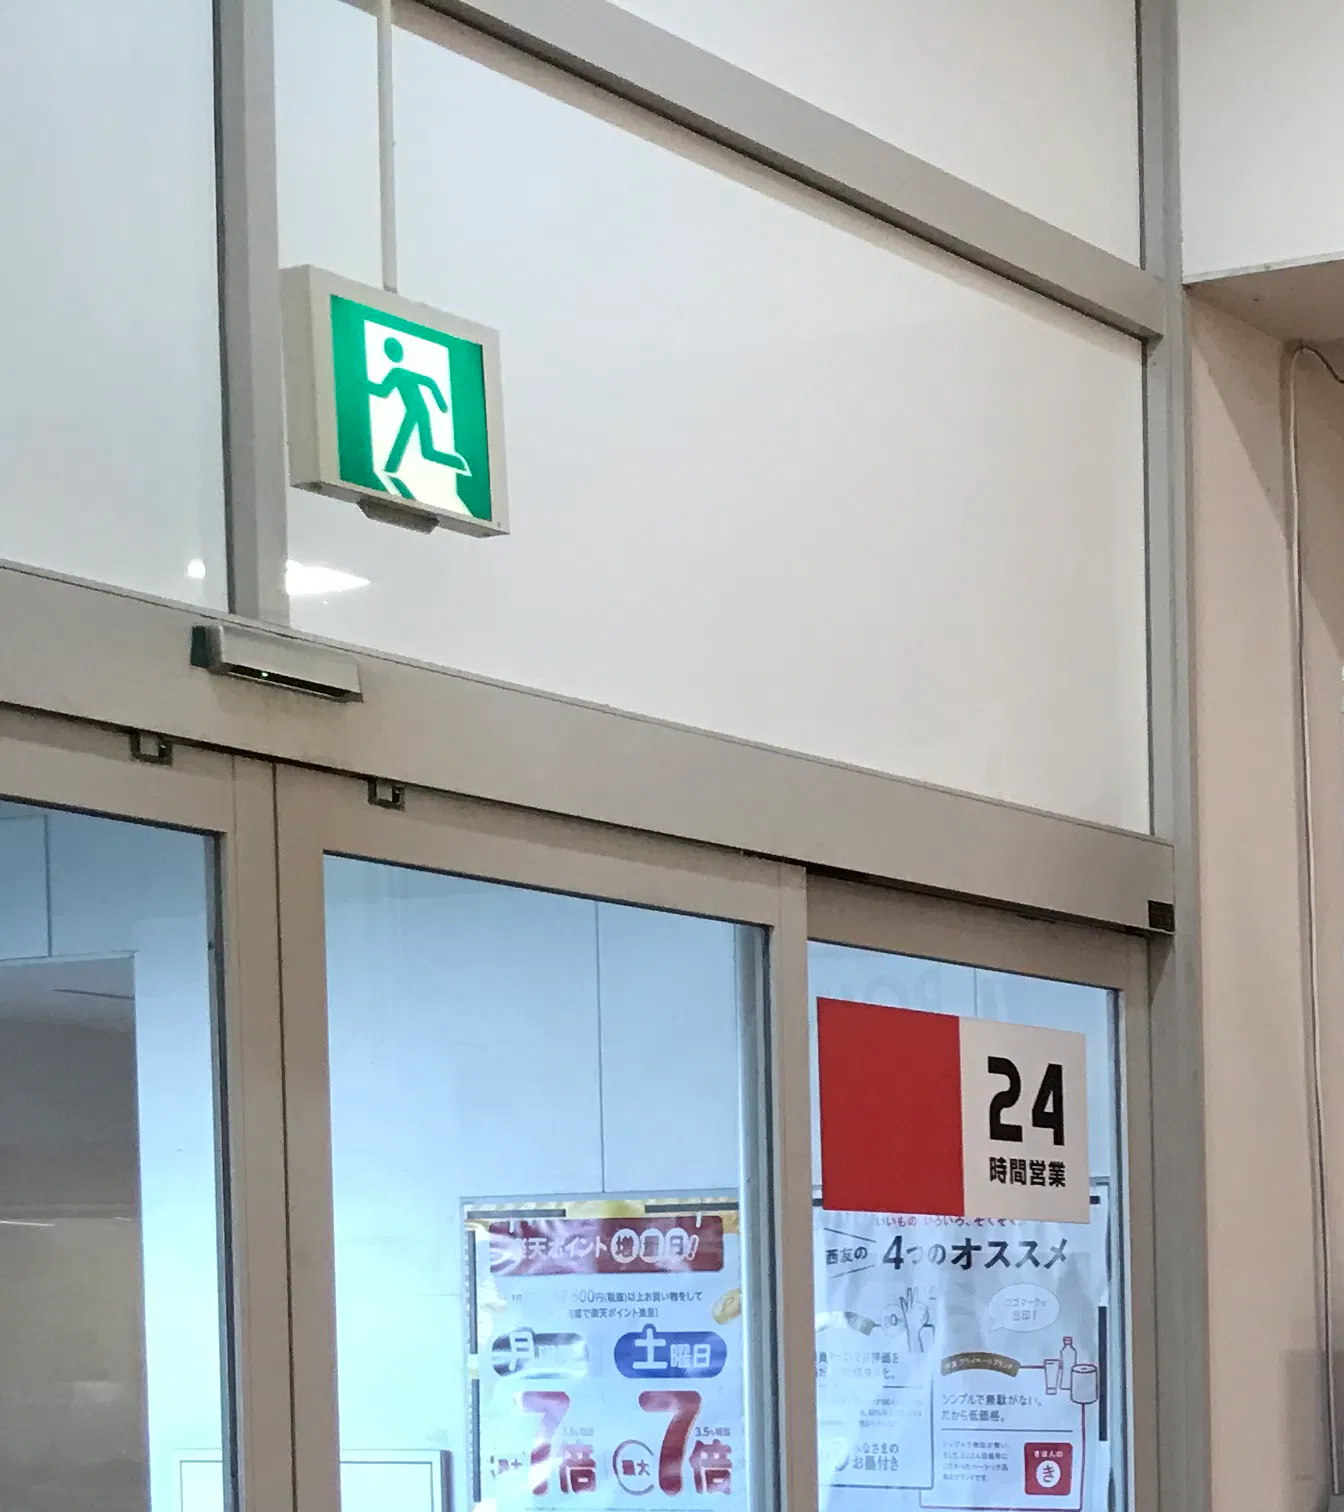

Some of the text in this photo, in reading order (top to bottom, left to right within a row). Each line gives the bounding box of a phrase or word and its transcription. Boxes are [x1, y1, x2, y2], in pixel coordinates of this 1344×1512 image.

[987, 1056, 1065, 1146] 24
[989, 1157, 1066, 1188] 時間営業
[882, 1235, 1067, 1270] 4つのオススメ
[632, 1327, 710, 1370] 土曜日
